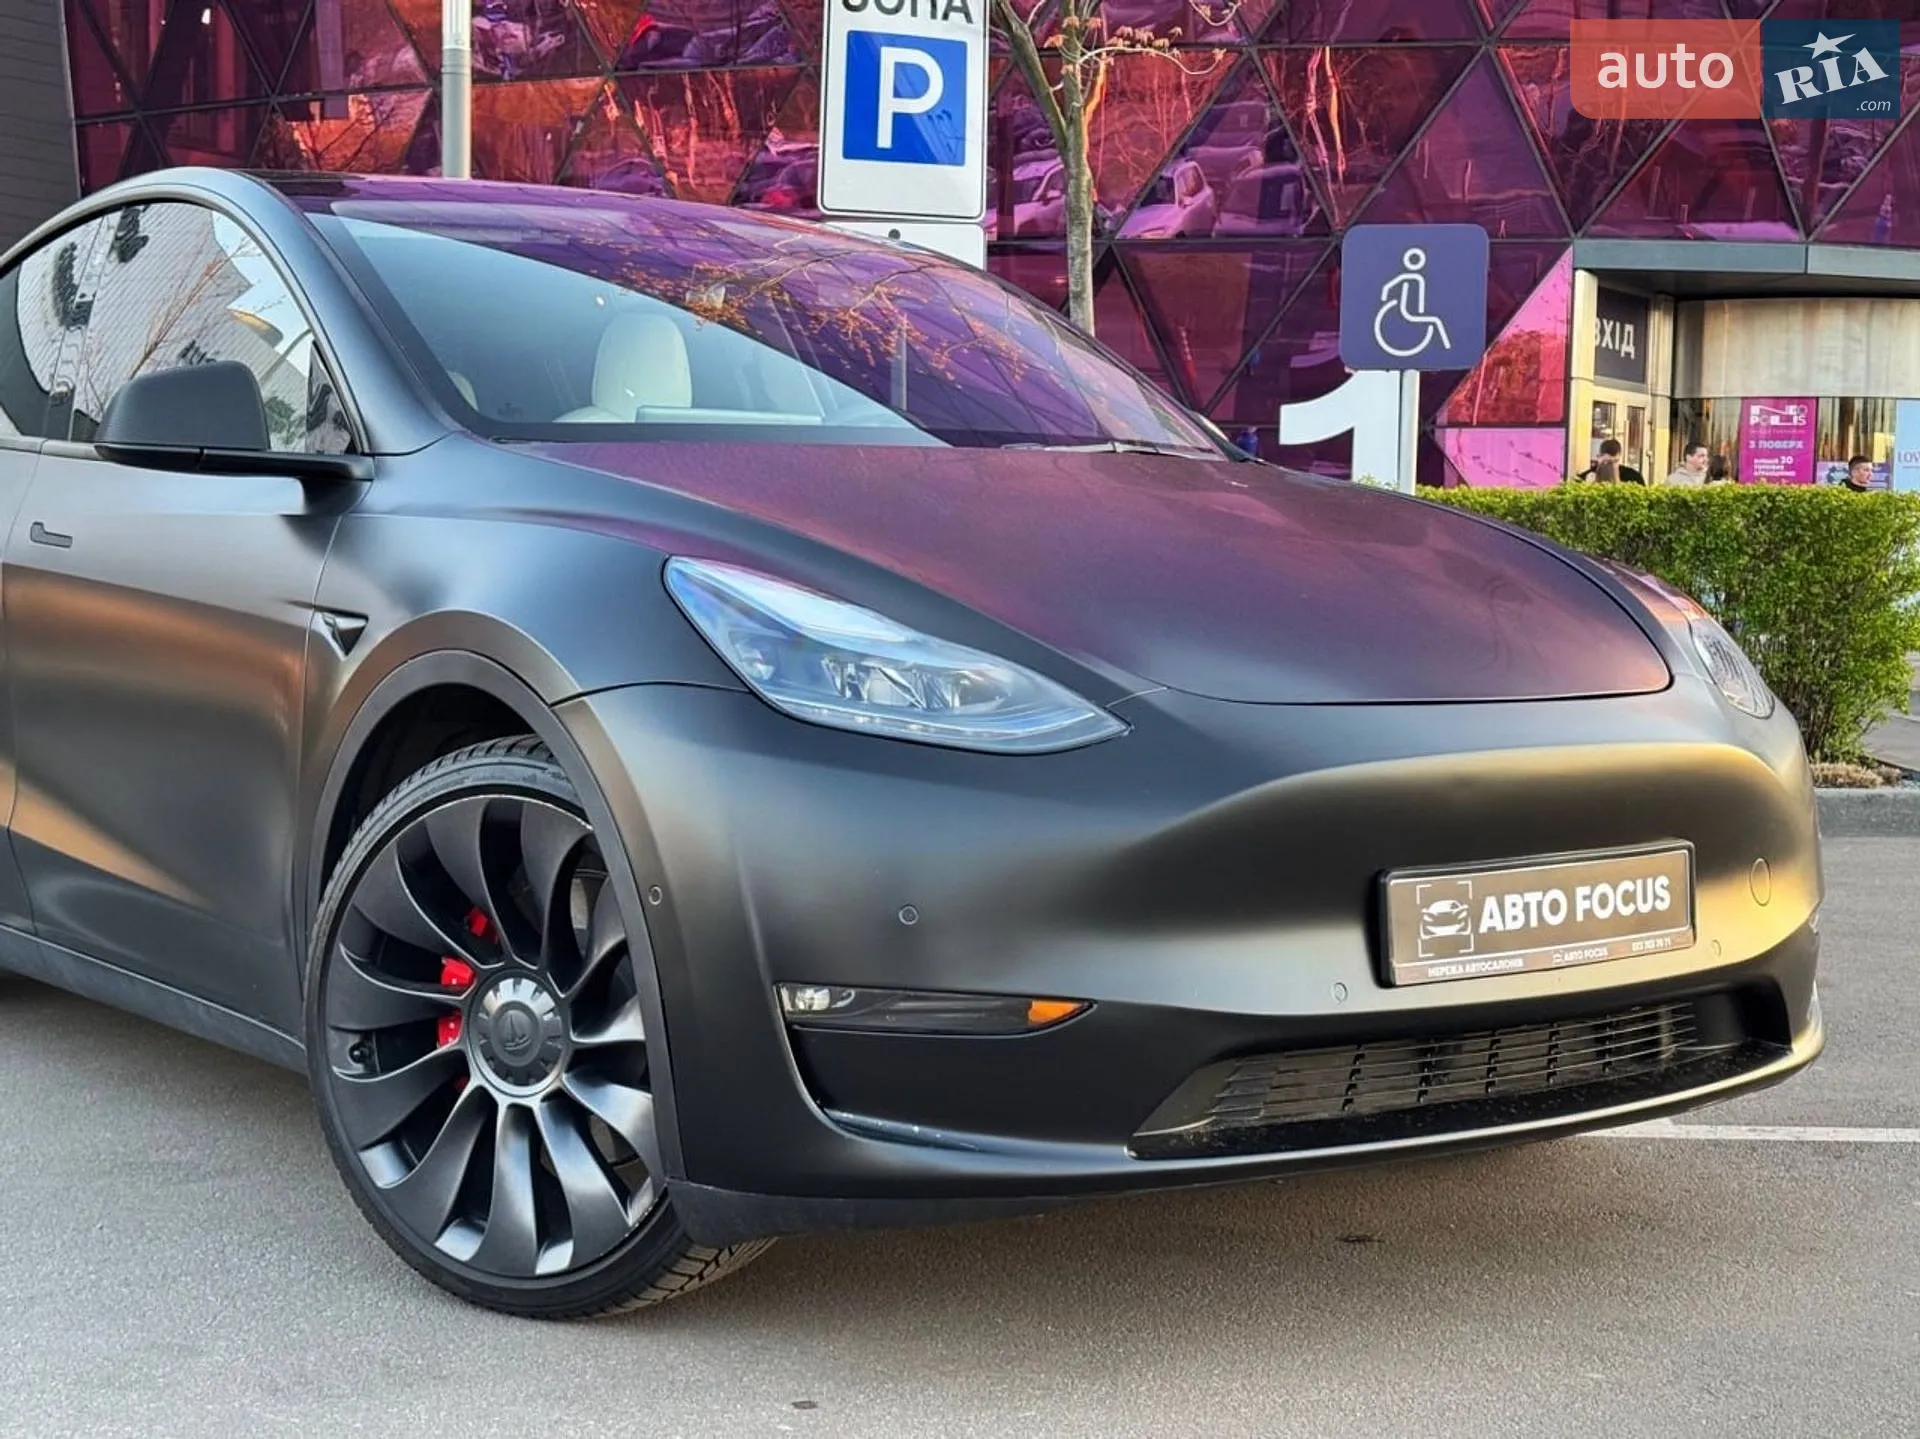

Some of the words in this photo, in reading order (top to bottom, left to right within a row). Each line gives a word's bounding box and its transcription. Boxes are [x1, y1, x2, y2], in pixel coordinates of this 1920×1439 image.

[876, 46, 944, 149] P
[1478, 888, 1567, 934] АВТО
[1575, 875, 1671, 922] FOCUS
